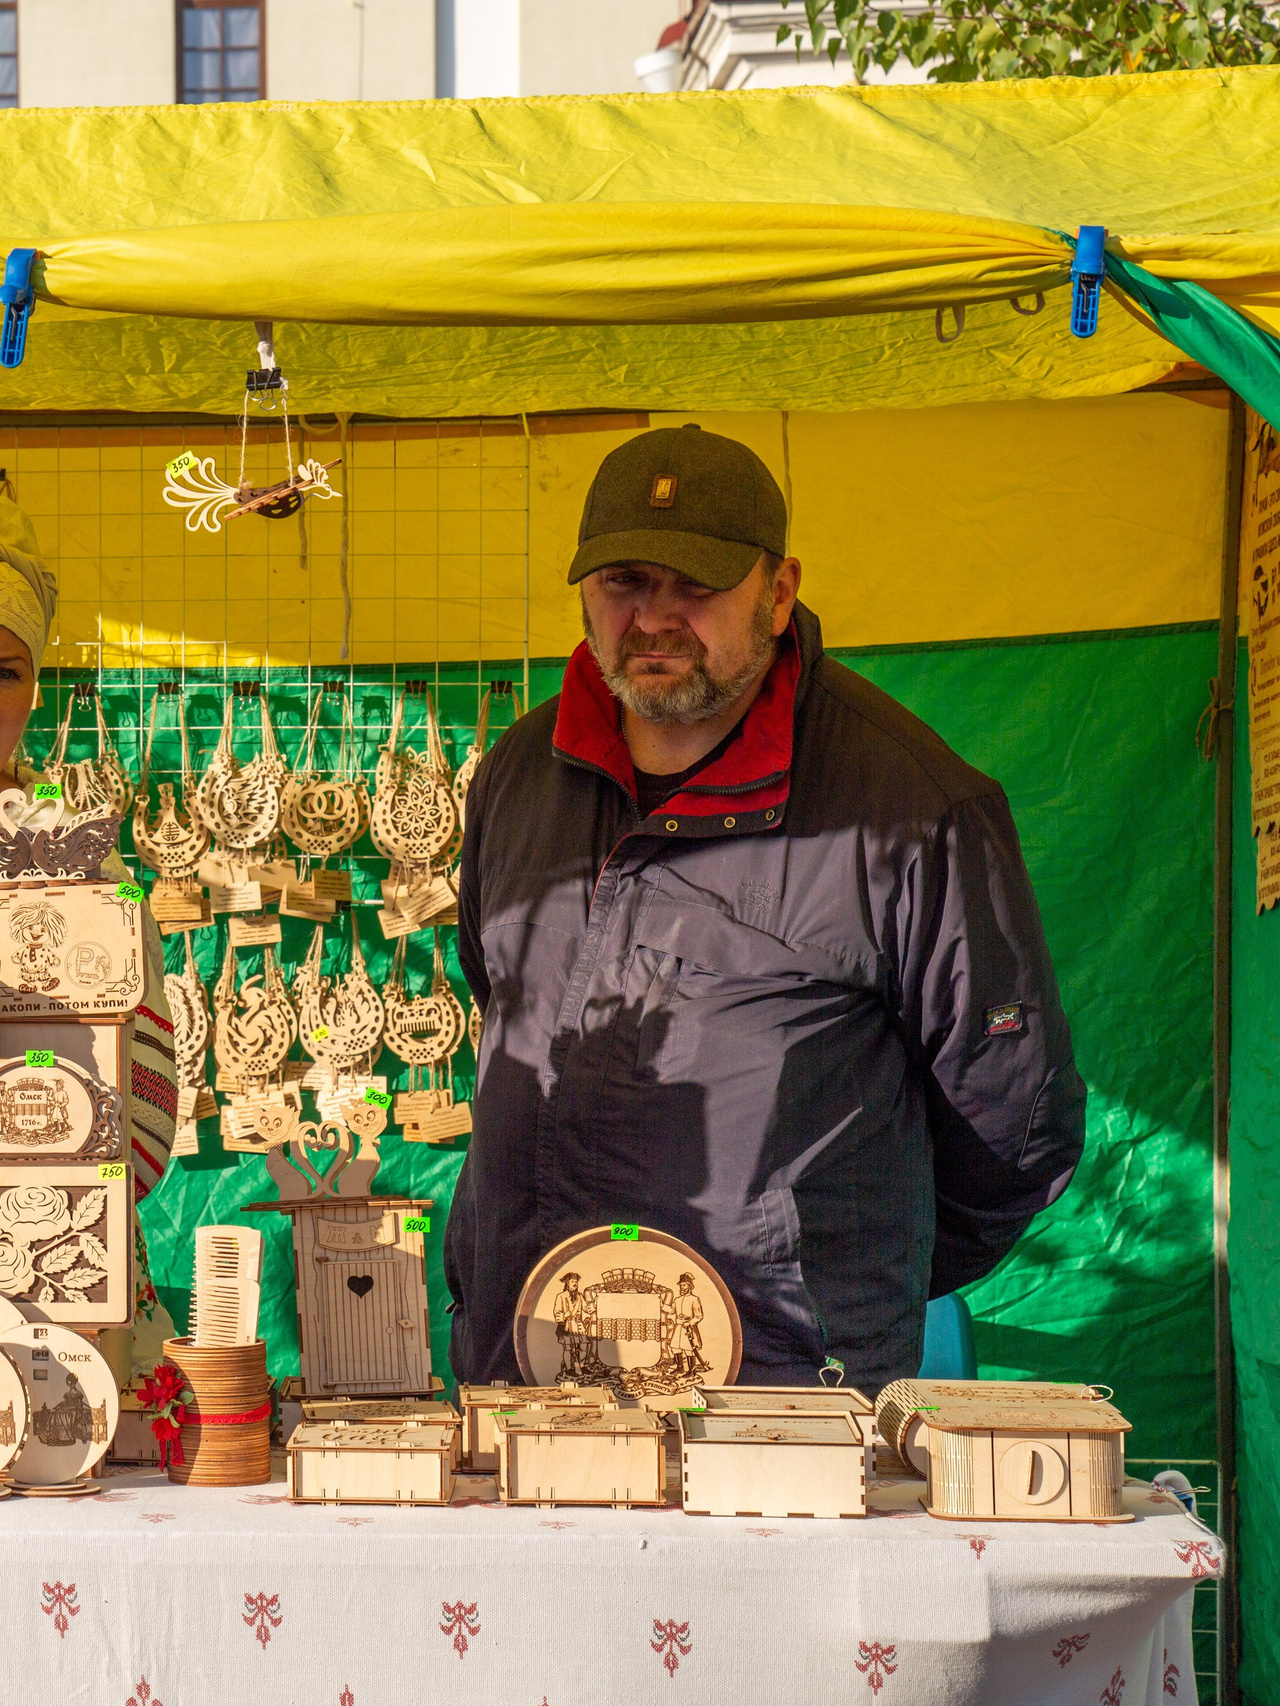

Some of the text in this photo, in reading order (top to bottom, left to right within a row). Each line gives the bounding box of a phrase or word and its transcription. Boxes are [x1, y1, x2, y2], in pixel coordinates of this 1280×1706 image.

[172, 456, 190, 474] 350
[38, 786, 58, 796] 350
[120, 886, 140, 898] 500
[48, 1001, 90, 1012] ПОТОМ
[93, 999, 128, 1008] КУПИ!
[28, 1052, 50, 1064] 350
[20, 1092, 42, 1101] Омск
[366, 1092, 388, 1105] 300
[101, 1166, 124, 1178] 750
[406, 1220, 426, 1232] 500
[613, 1226, 634, 1236] 900
[326, 1225, 346, 1244] Ж
[58, 1351, 92, 1362] Омск
